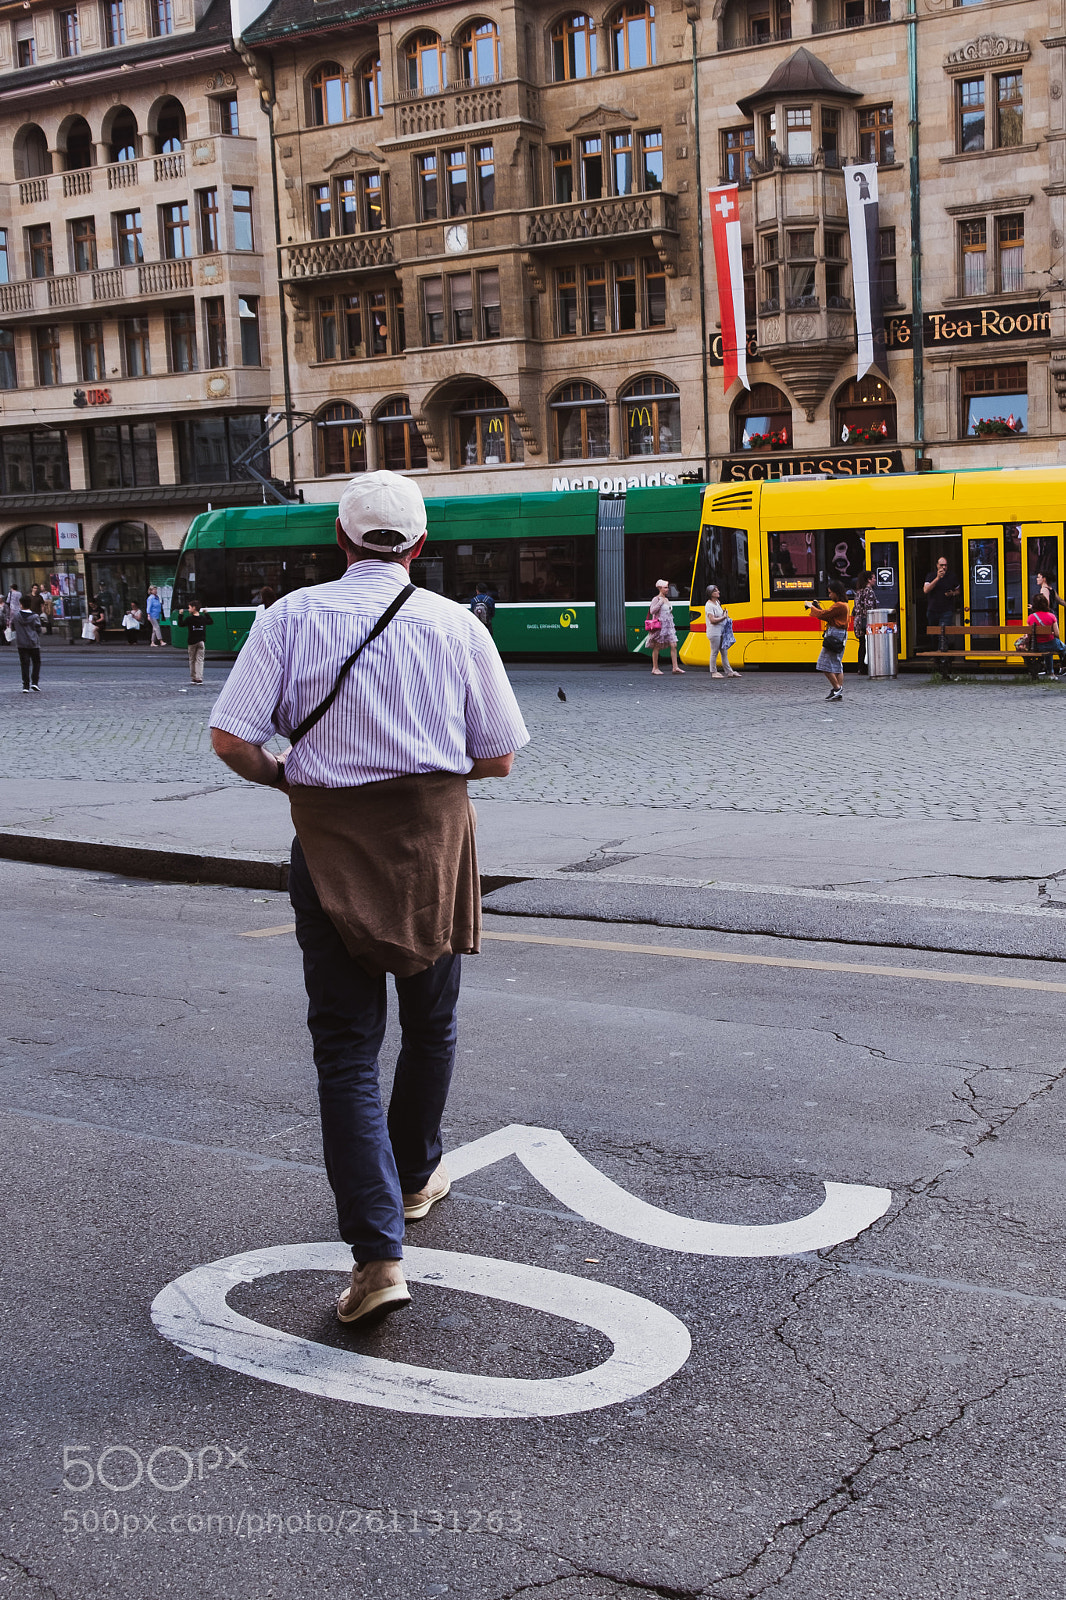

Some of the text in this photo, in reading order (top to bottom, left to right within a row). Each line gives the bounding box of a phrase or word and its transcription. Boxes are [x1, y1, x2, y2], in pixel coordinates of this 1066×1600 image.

[928, 309, 1051, 340] Tea-Room
[87, 388, 112, 405] UBS
[729, 456, 893, 482] SCHIESSER
[551, 471, 678, 495] McDonald's
[66, 531, 78, 540] UBS
